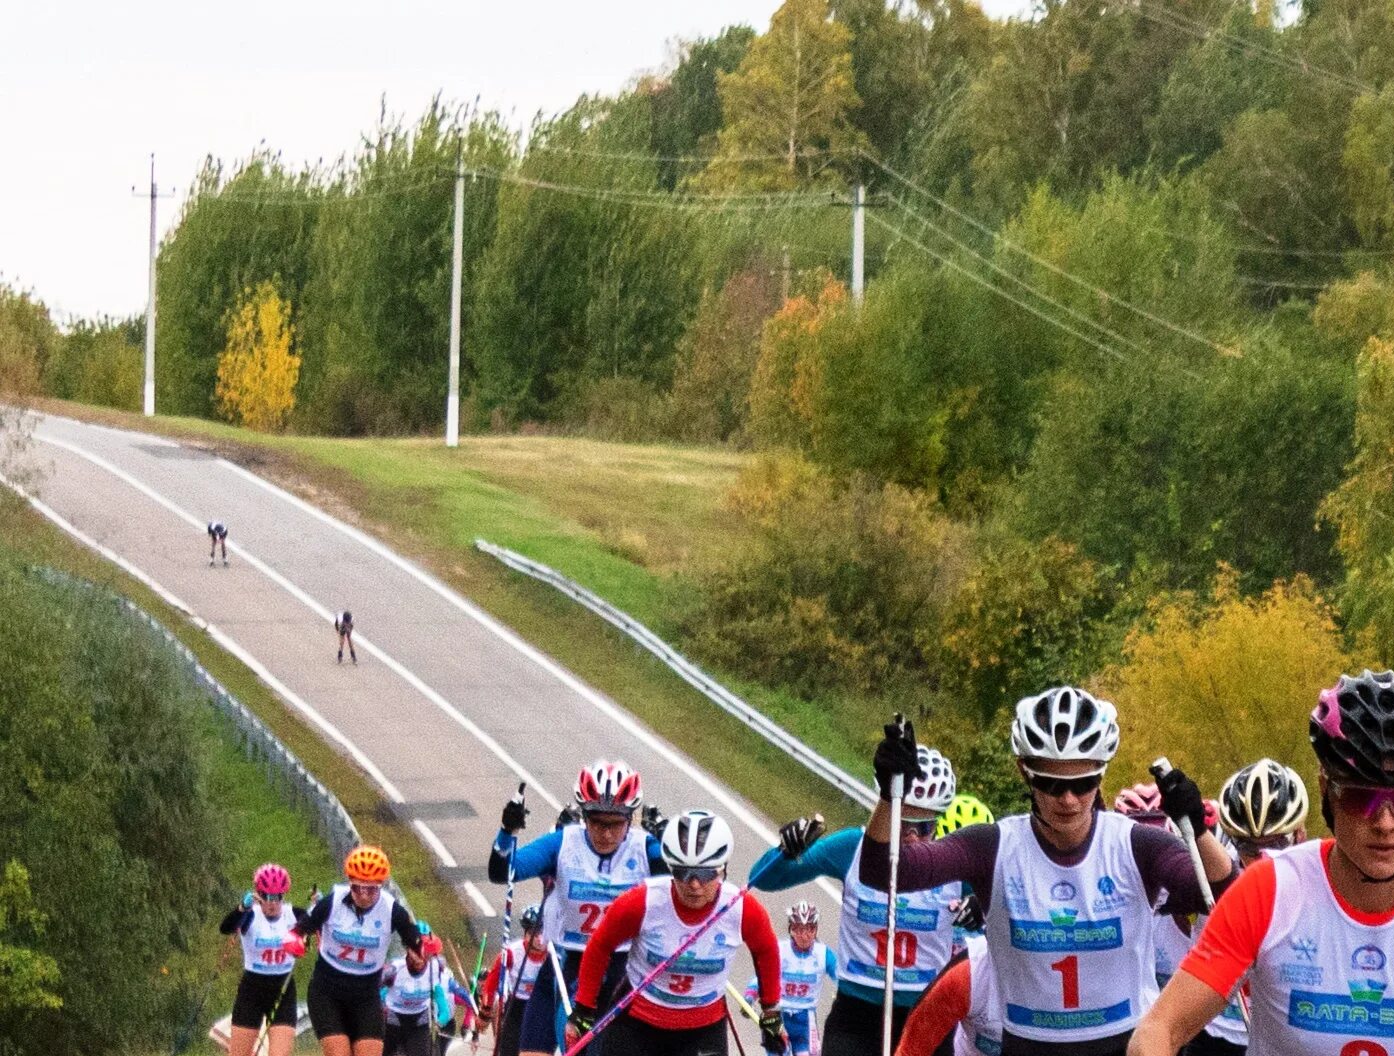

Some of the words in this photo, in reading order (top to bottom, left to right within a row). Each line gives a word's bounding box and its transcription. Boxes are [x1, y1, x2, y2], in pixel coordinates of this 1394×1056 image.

[337, 945, 368, 964] 21
[869, 929, 918, 969] 10
[1051, 955, 1080, 1009] 1
